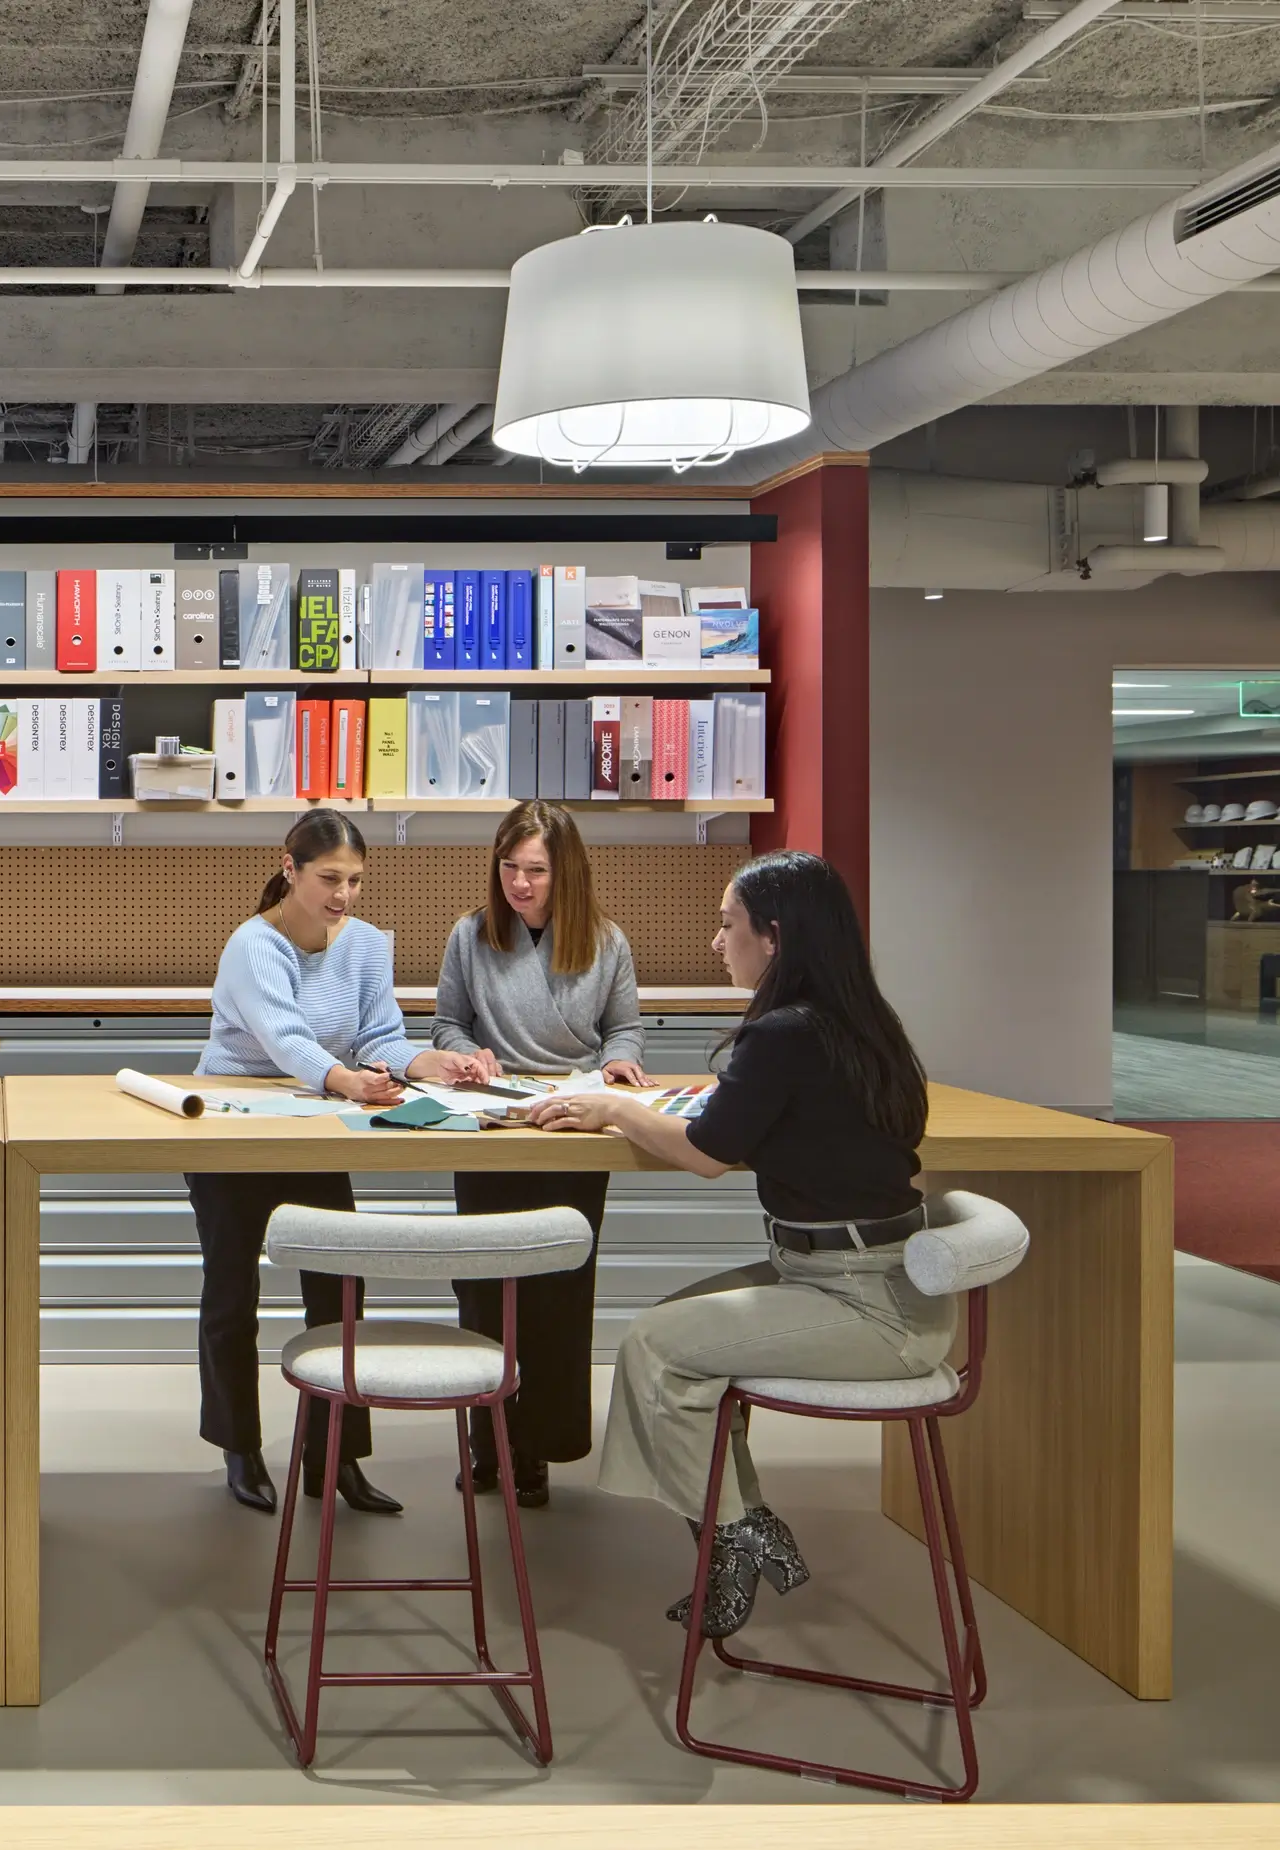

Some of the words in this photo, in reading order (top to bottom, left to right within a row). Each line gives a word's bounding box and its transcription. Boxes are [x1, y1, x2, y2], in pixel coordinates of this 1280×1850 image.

[542, 567, 551, 575] K
[567, 571, 574, 579] K
[114, 583, 123, 608] Seating
[153, 590, 162, 614] Seating
[36, 592, 46, 649] Humanscale
[653, 630, 691, 639] GENON
[601, 732, 612, 783] ARBORITE
